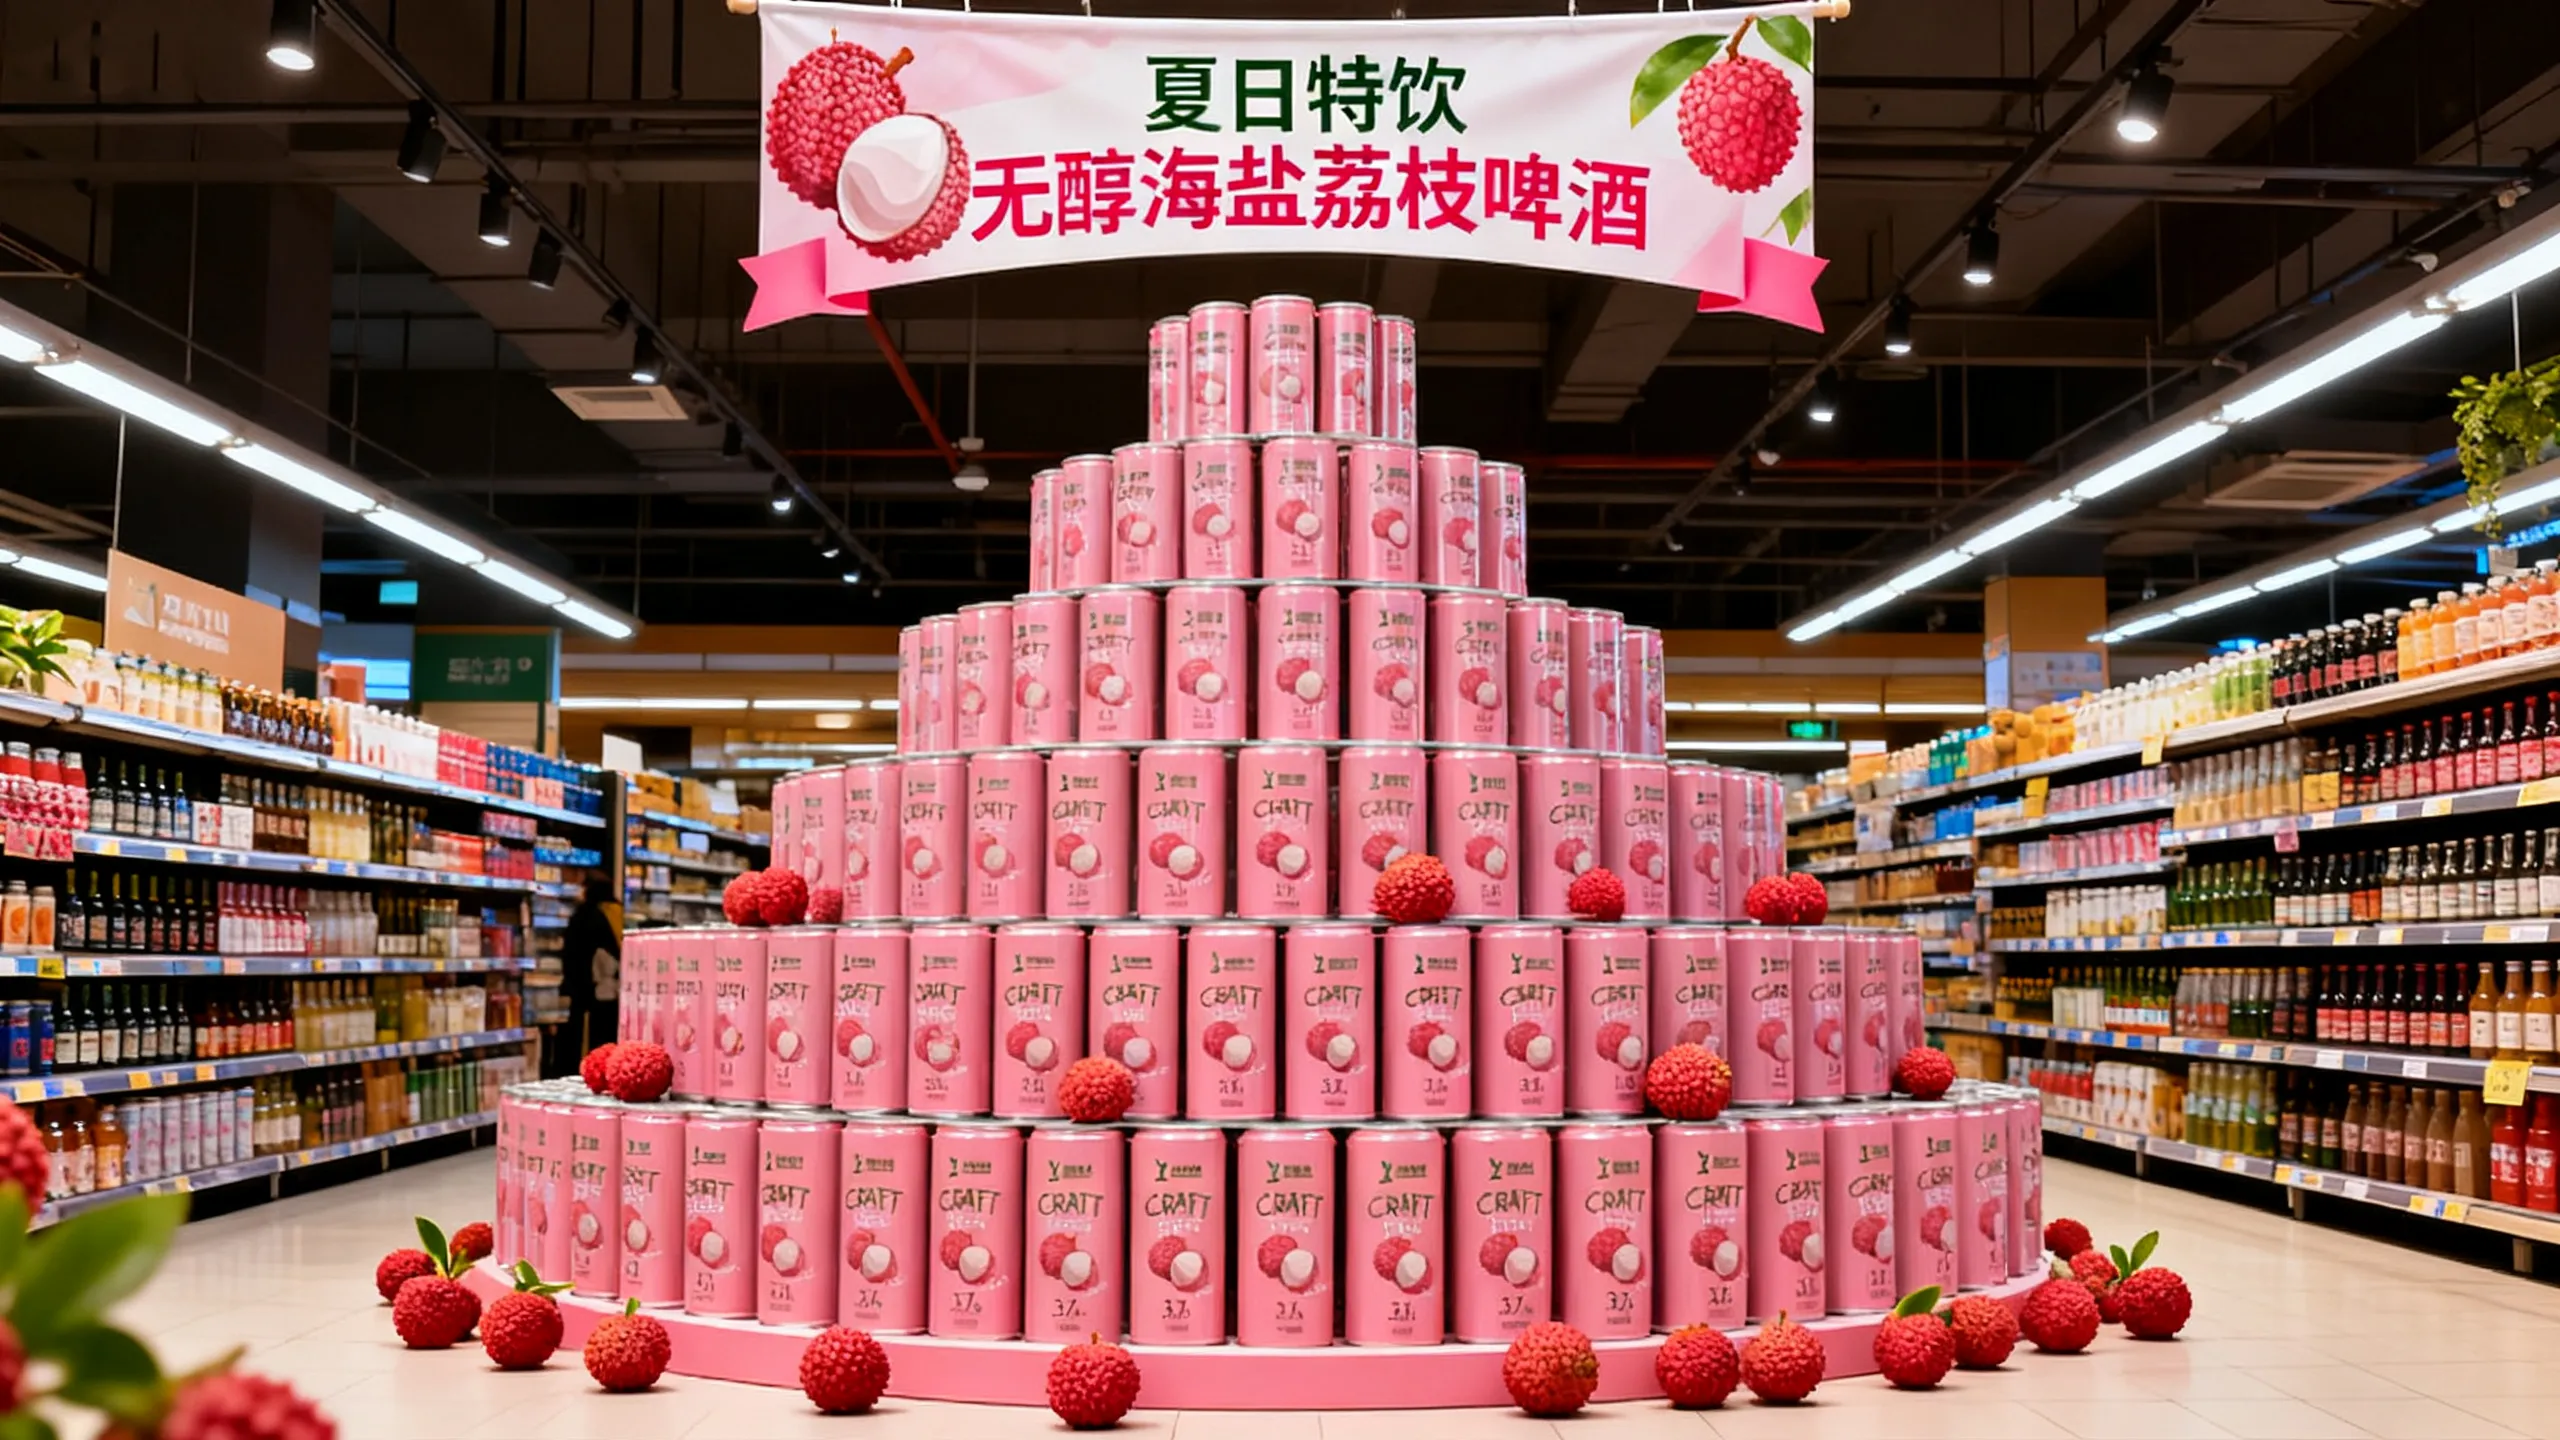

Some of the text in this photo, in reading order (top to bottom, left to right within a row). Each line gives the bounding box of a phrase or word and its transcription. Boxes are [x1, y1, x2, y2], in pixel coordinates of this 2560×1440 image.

[1145, 55, 1467, 135] 夏日特饮
[971, 145, 1650, 250] 无醇海盐荔枝啤酒
[1145, 1192, 1212, 1219] CRAFT
[1256, 1192, 1324, 1218] CRAFT
[1368, 1193, 1435, 1218] CRAFT
[1476, 1189, 1543, 1215] CRAFT
